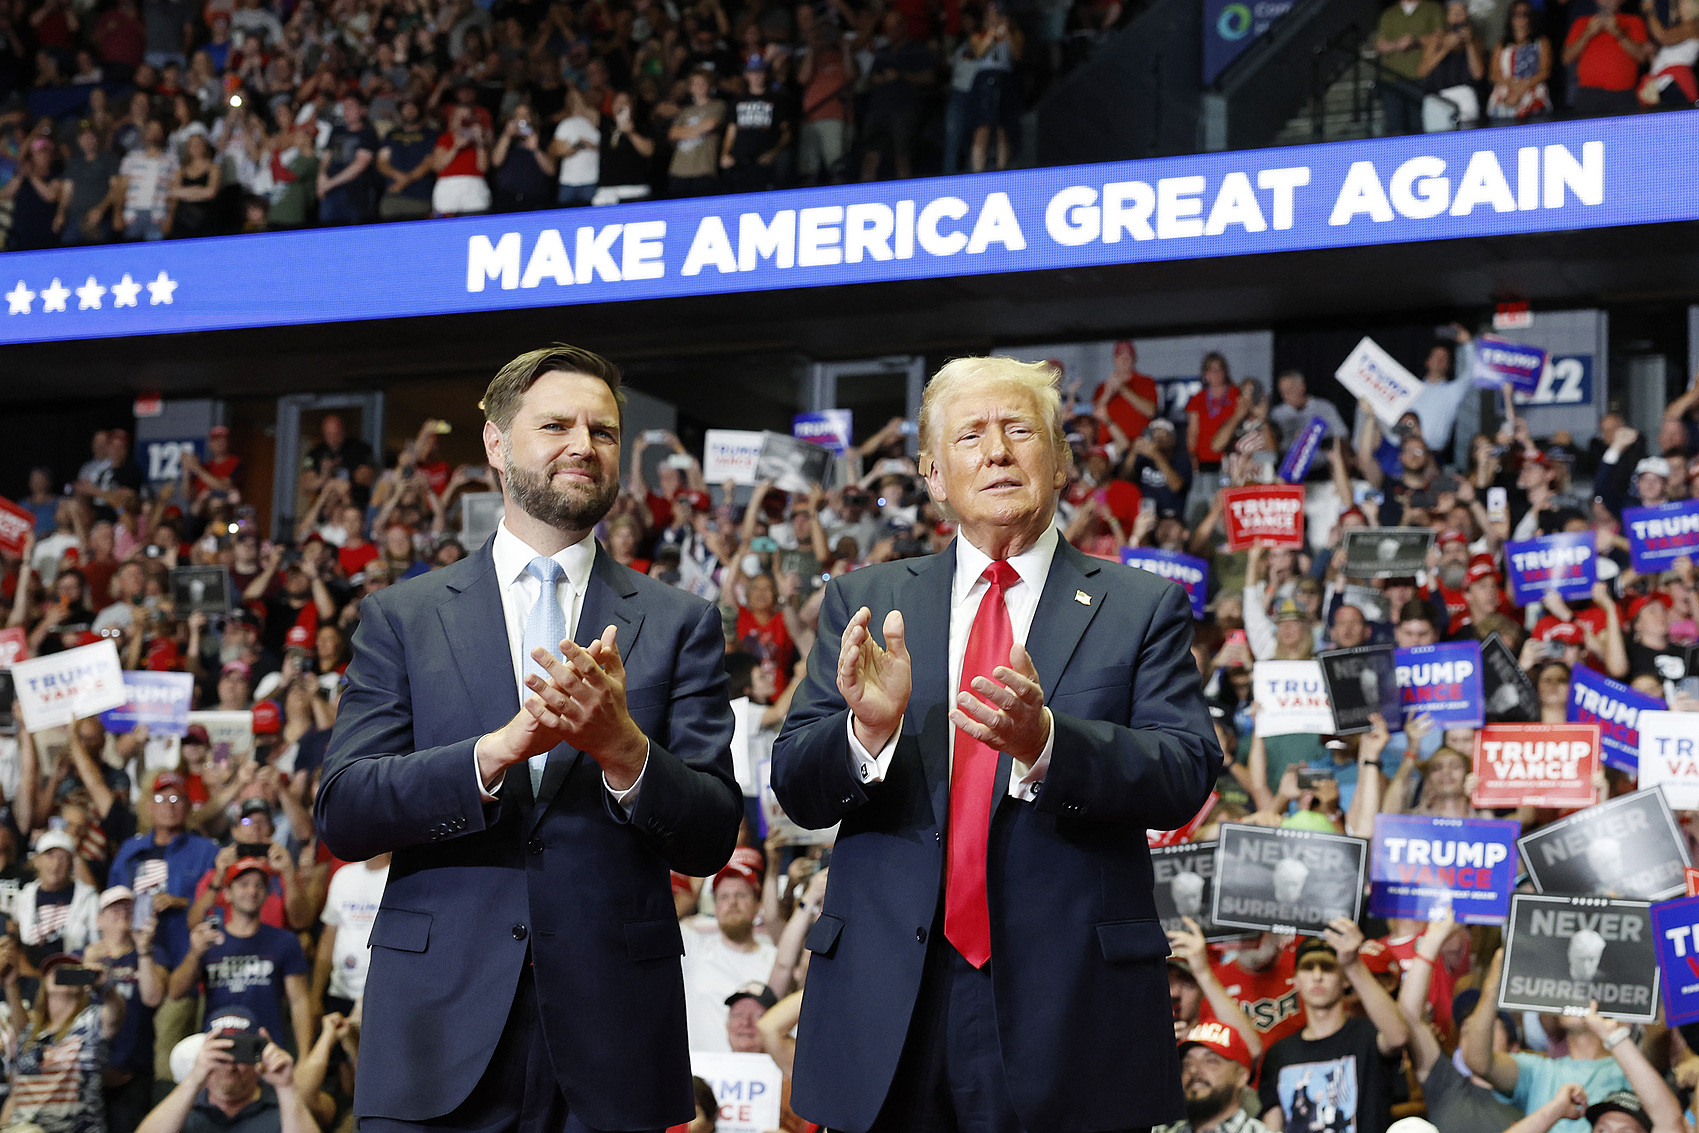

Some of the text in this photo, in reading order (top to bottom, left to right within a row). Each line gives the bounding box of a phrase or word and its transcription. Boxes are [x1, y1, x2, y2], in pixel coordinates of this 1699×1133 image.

[466, 140, 1604, 292] MAKE AMERICA GREAT AGAIN
[1229, 498, 1301, 519] TRUMP
[1631, 513, 1699, 541] TRUM
[1511, 545, 1592, 573] TRUMP
[1268, 680, 1328, 694] TRU
[1395, 659, 1474, 688] RUMP
[1400, 683, 1464, 703] ANCE
[1574, 682, 1640, 732] TRUM
[1481, 740, 1592, 763] TRUMP
[1492, 760, 1579, 780] VANCE
[1540, 806, 1650, 867] NEVER
[1239, 837, 1346, 870] NEVER
[1383, 837, 1508, 869] TRUMP
[1154, 854, 1213, 884] EVE
[1397, 863, 1494, 890] VANCE
[1530, 908, 1644, 943] NEVER
[206, 958, 275, 982] TRUMP
[1509, 975, 1650, 1006] SURRENDER
